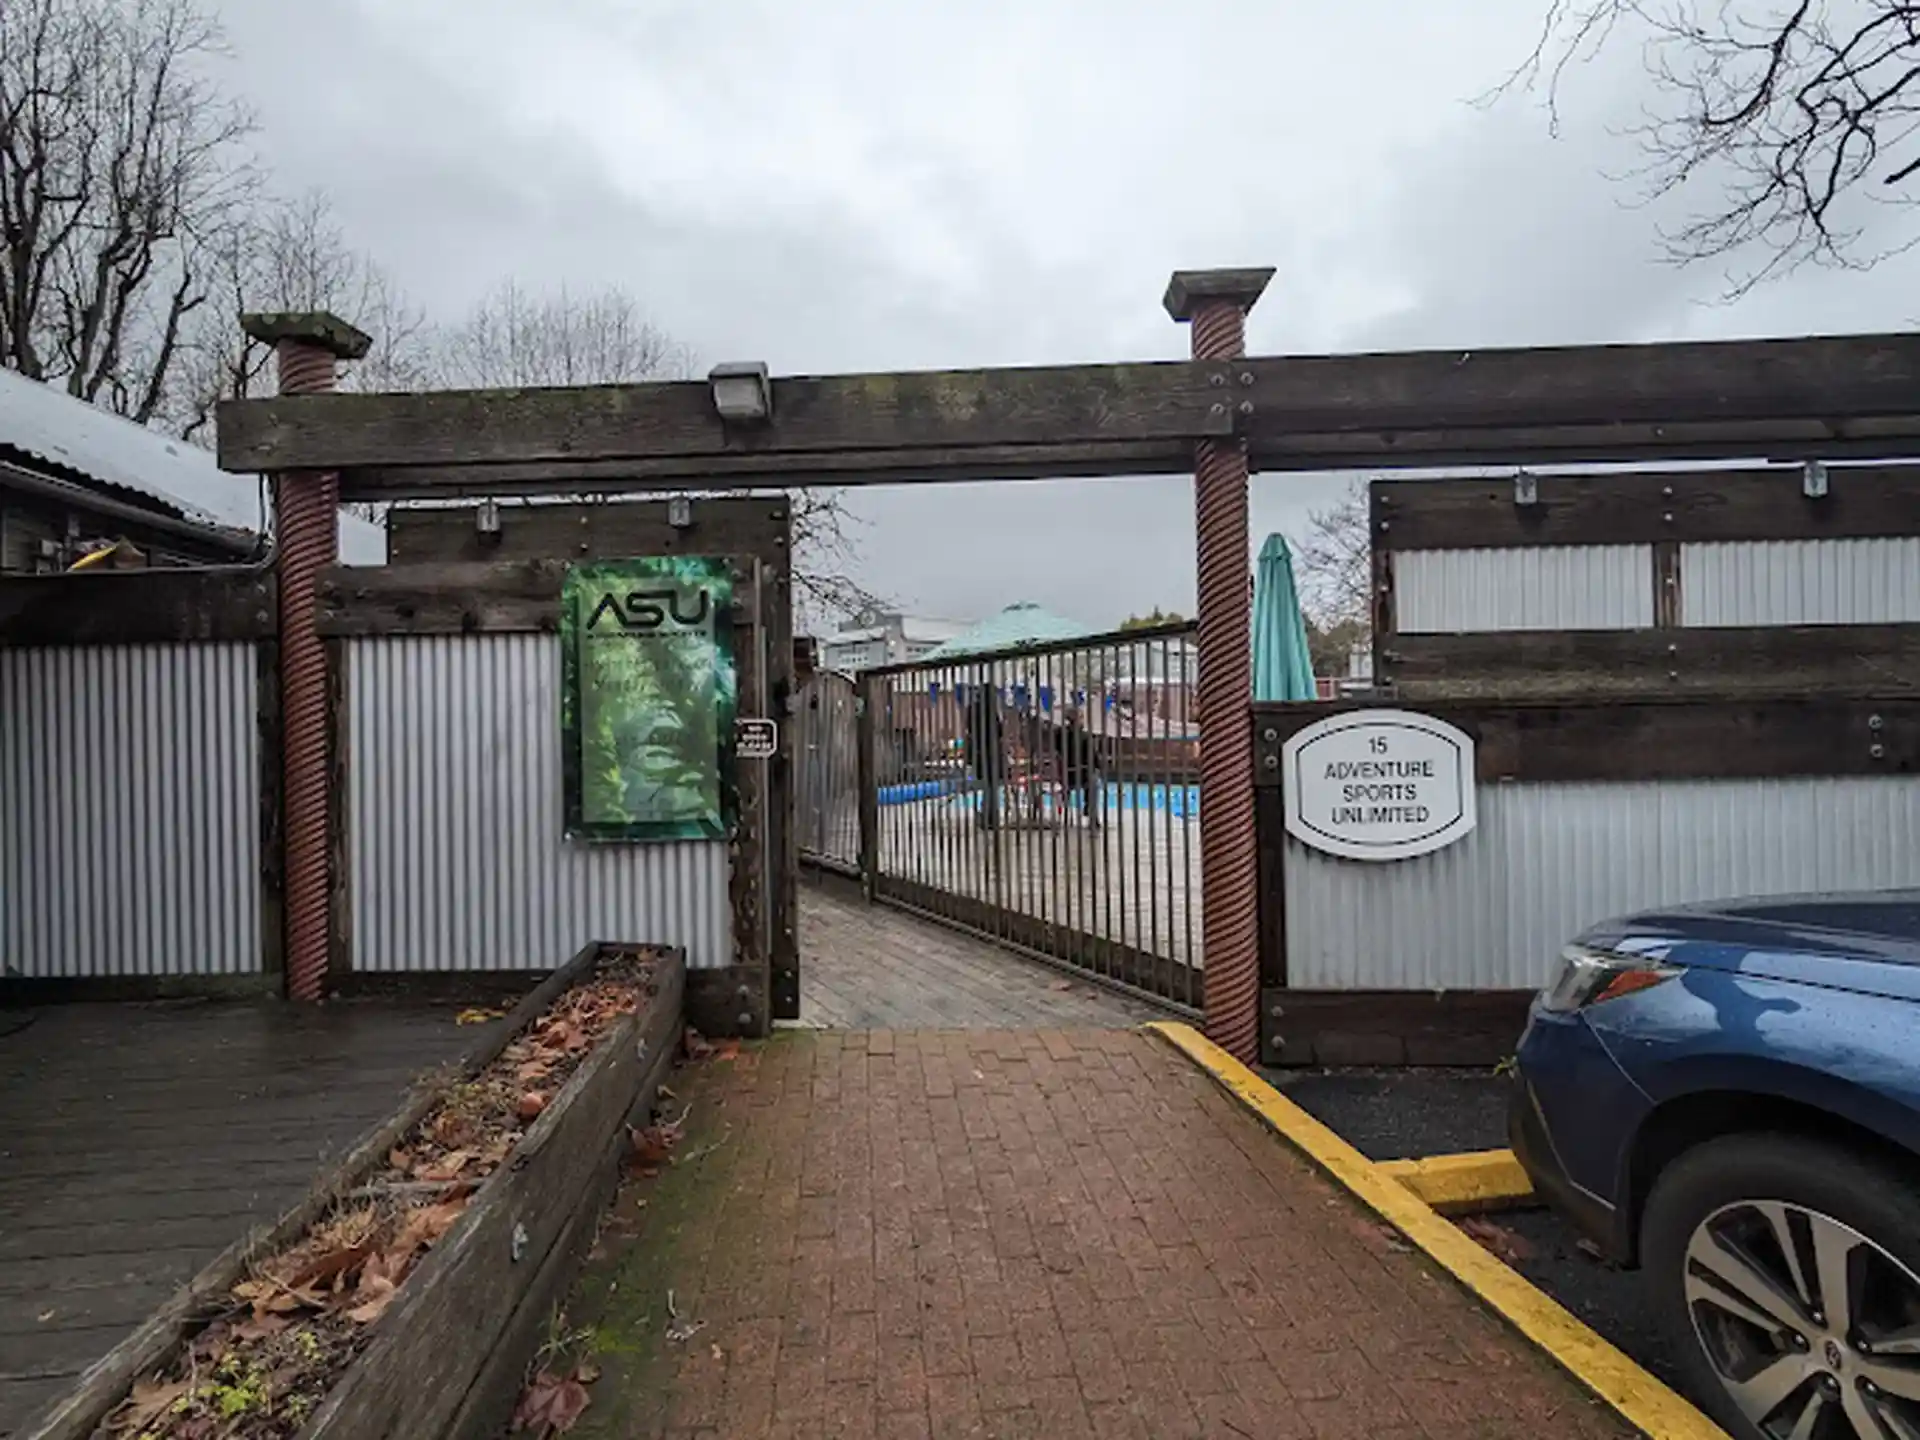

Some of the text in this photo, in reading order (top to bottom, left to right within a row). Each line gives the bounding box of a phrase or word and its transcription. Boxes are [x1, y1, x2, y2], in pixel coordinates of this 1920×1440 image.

[586, 589, 708, 630] ASU
[1368, 737, 1388, 754] 15
[1324, 760, 1434, 780] ADVENTURE
[1342, 784, 1417, 802] SPORTS
[1331, 806, 1430, 824] UNLIMITED
